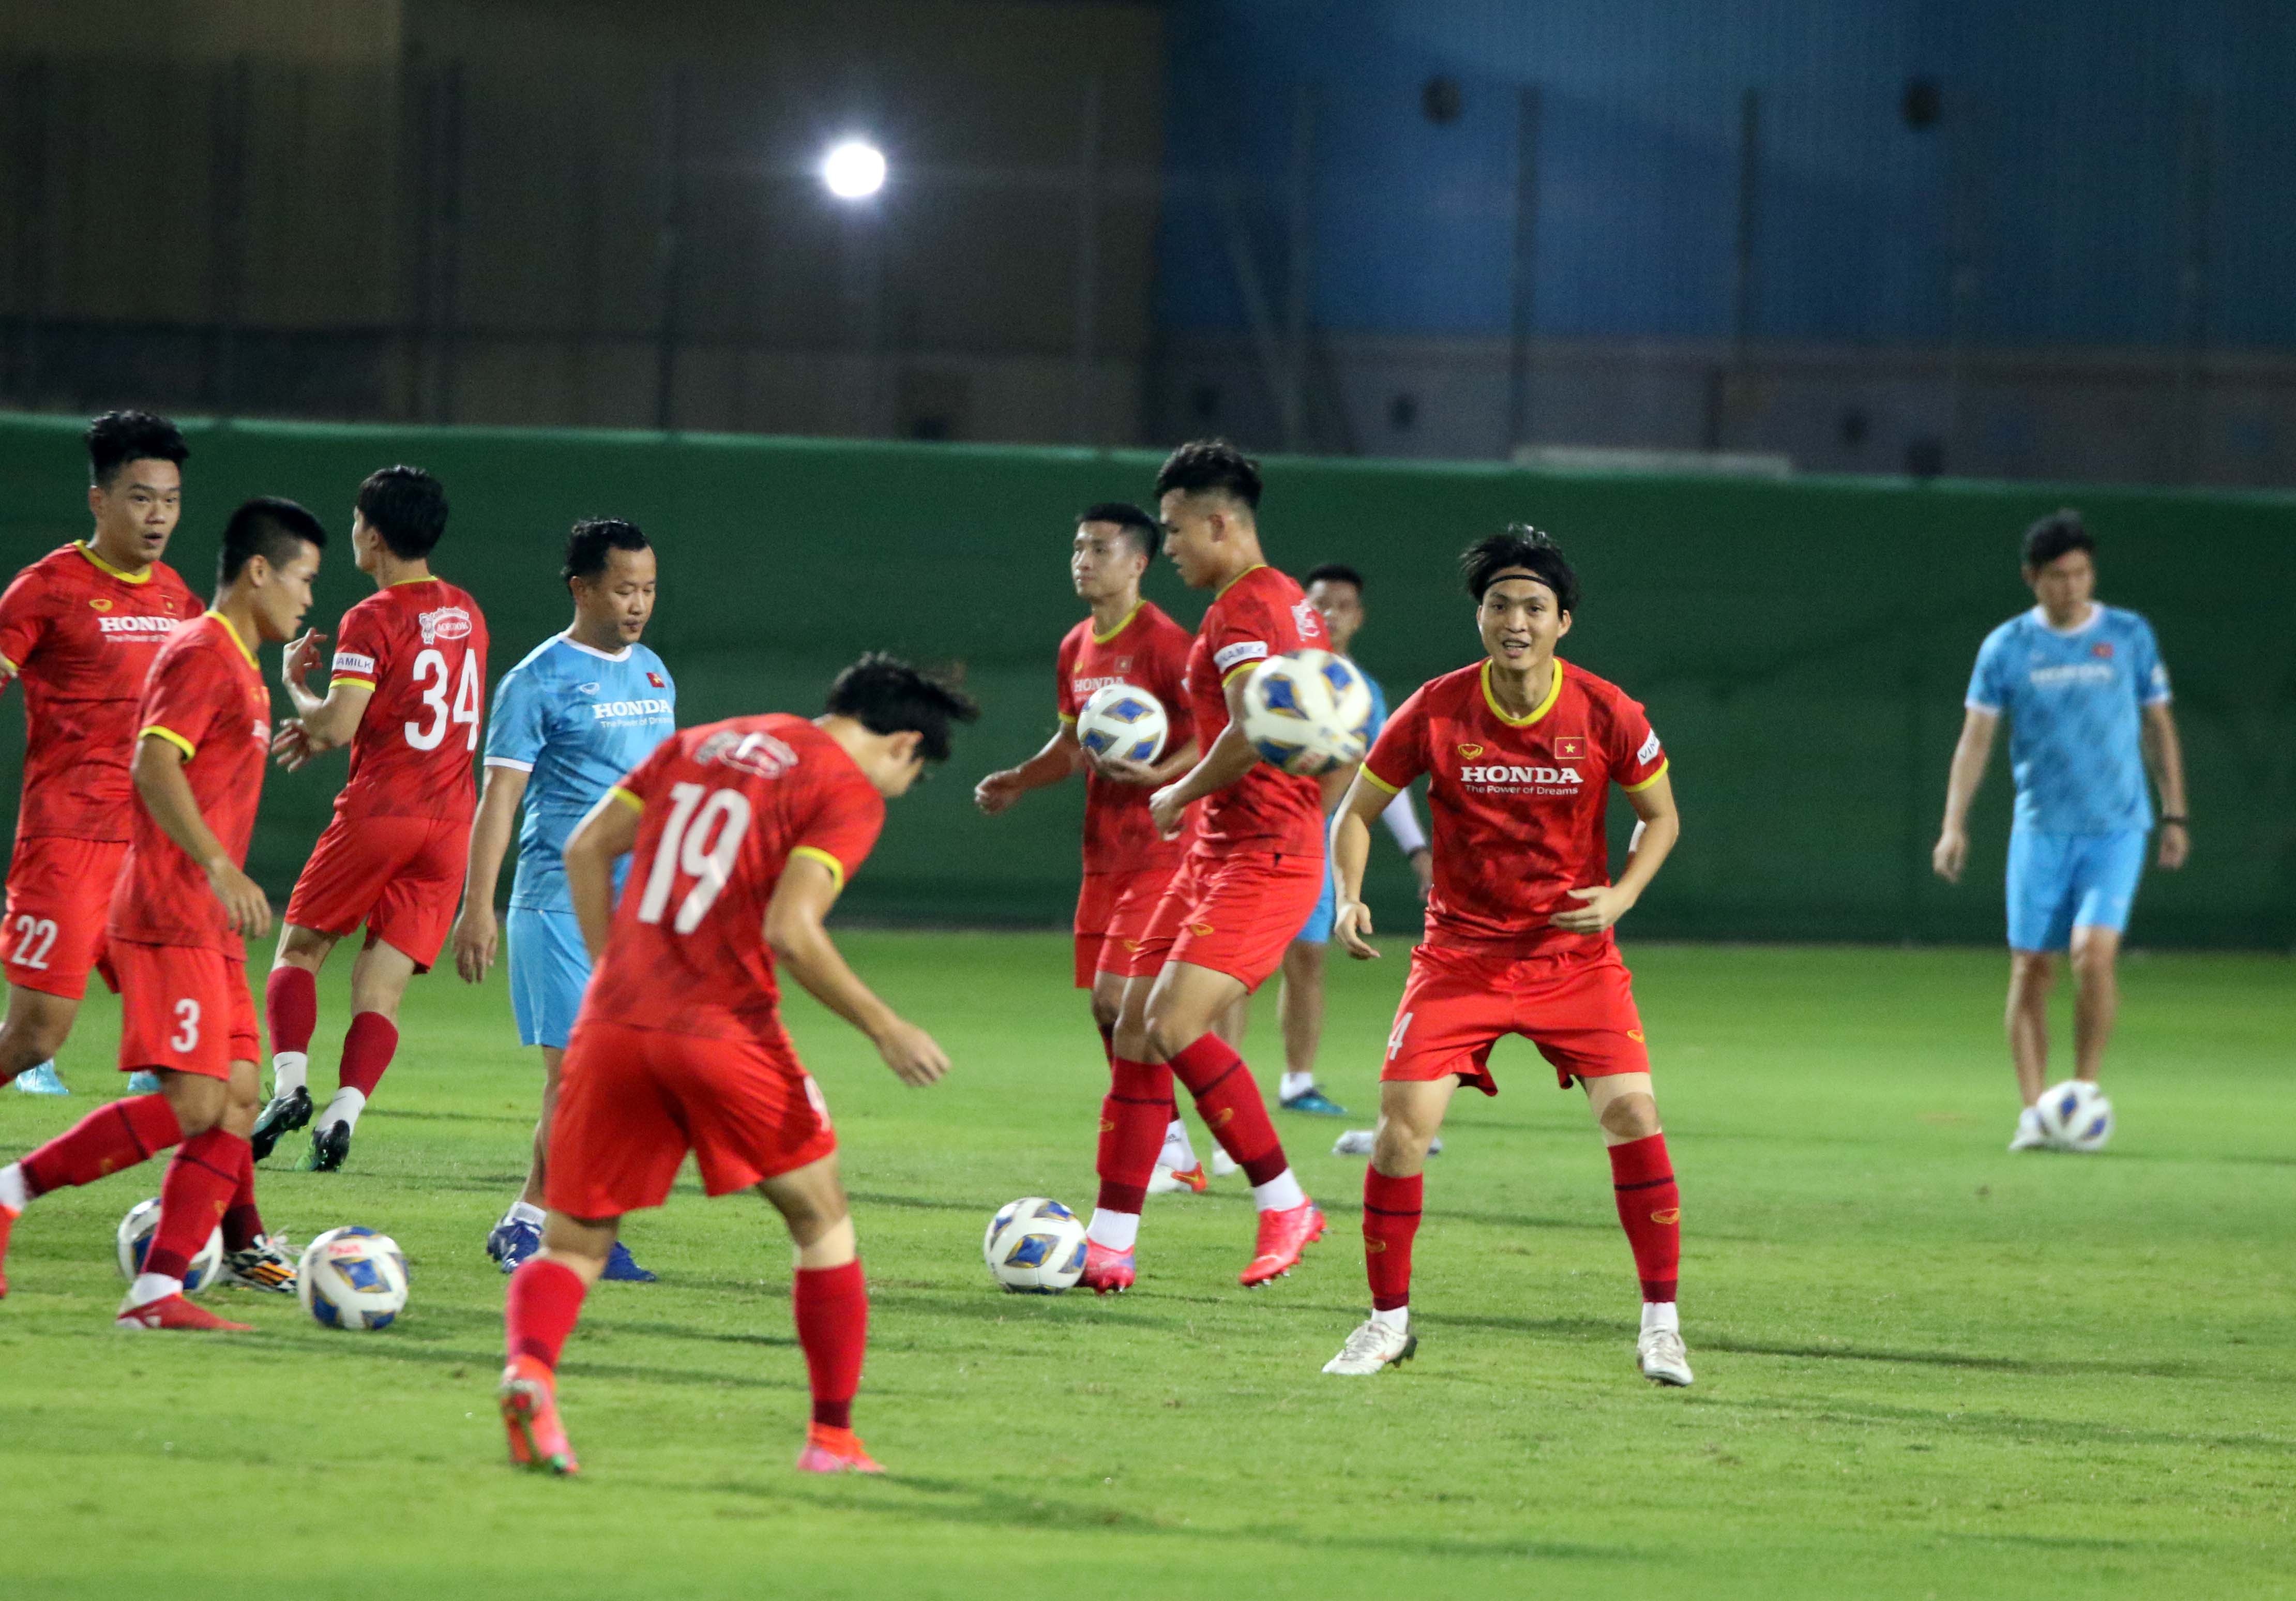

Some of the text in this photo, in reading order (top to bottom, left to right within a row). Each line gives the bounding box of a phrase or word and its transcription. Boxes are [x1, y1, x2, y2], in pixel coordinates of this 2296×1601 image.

[404, 648, 479, 750] 34
[592, 700, 673, 719] HONDA
[1460, 765, 1584, 783] HONDA
[1466, 784, 1485, 793] The
[1487, 785, 1520, 794] Power
[1536, 786, 1578, 795] Dreams
[637, 782, 751, 935] 19
[10, 915, 58, 970] 22
[171, 998, 201, 1052] 3
[1388, 1012, 1414, 1061] 4
